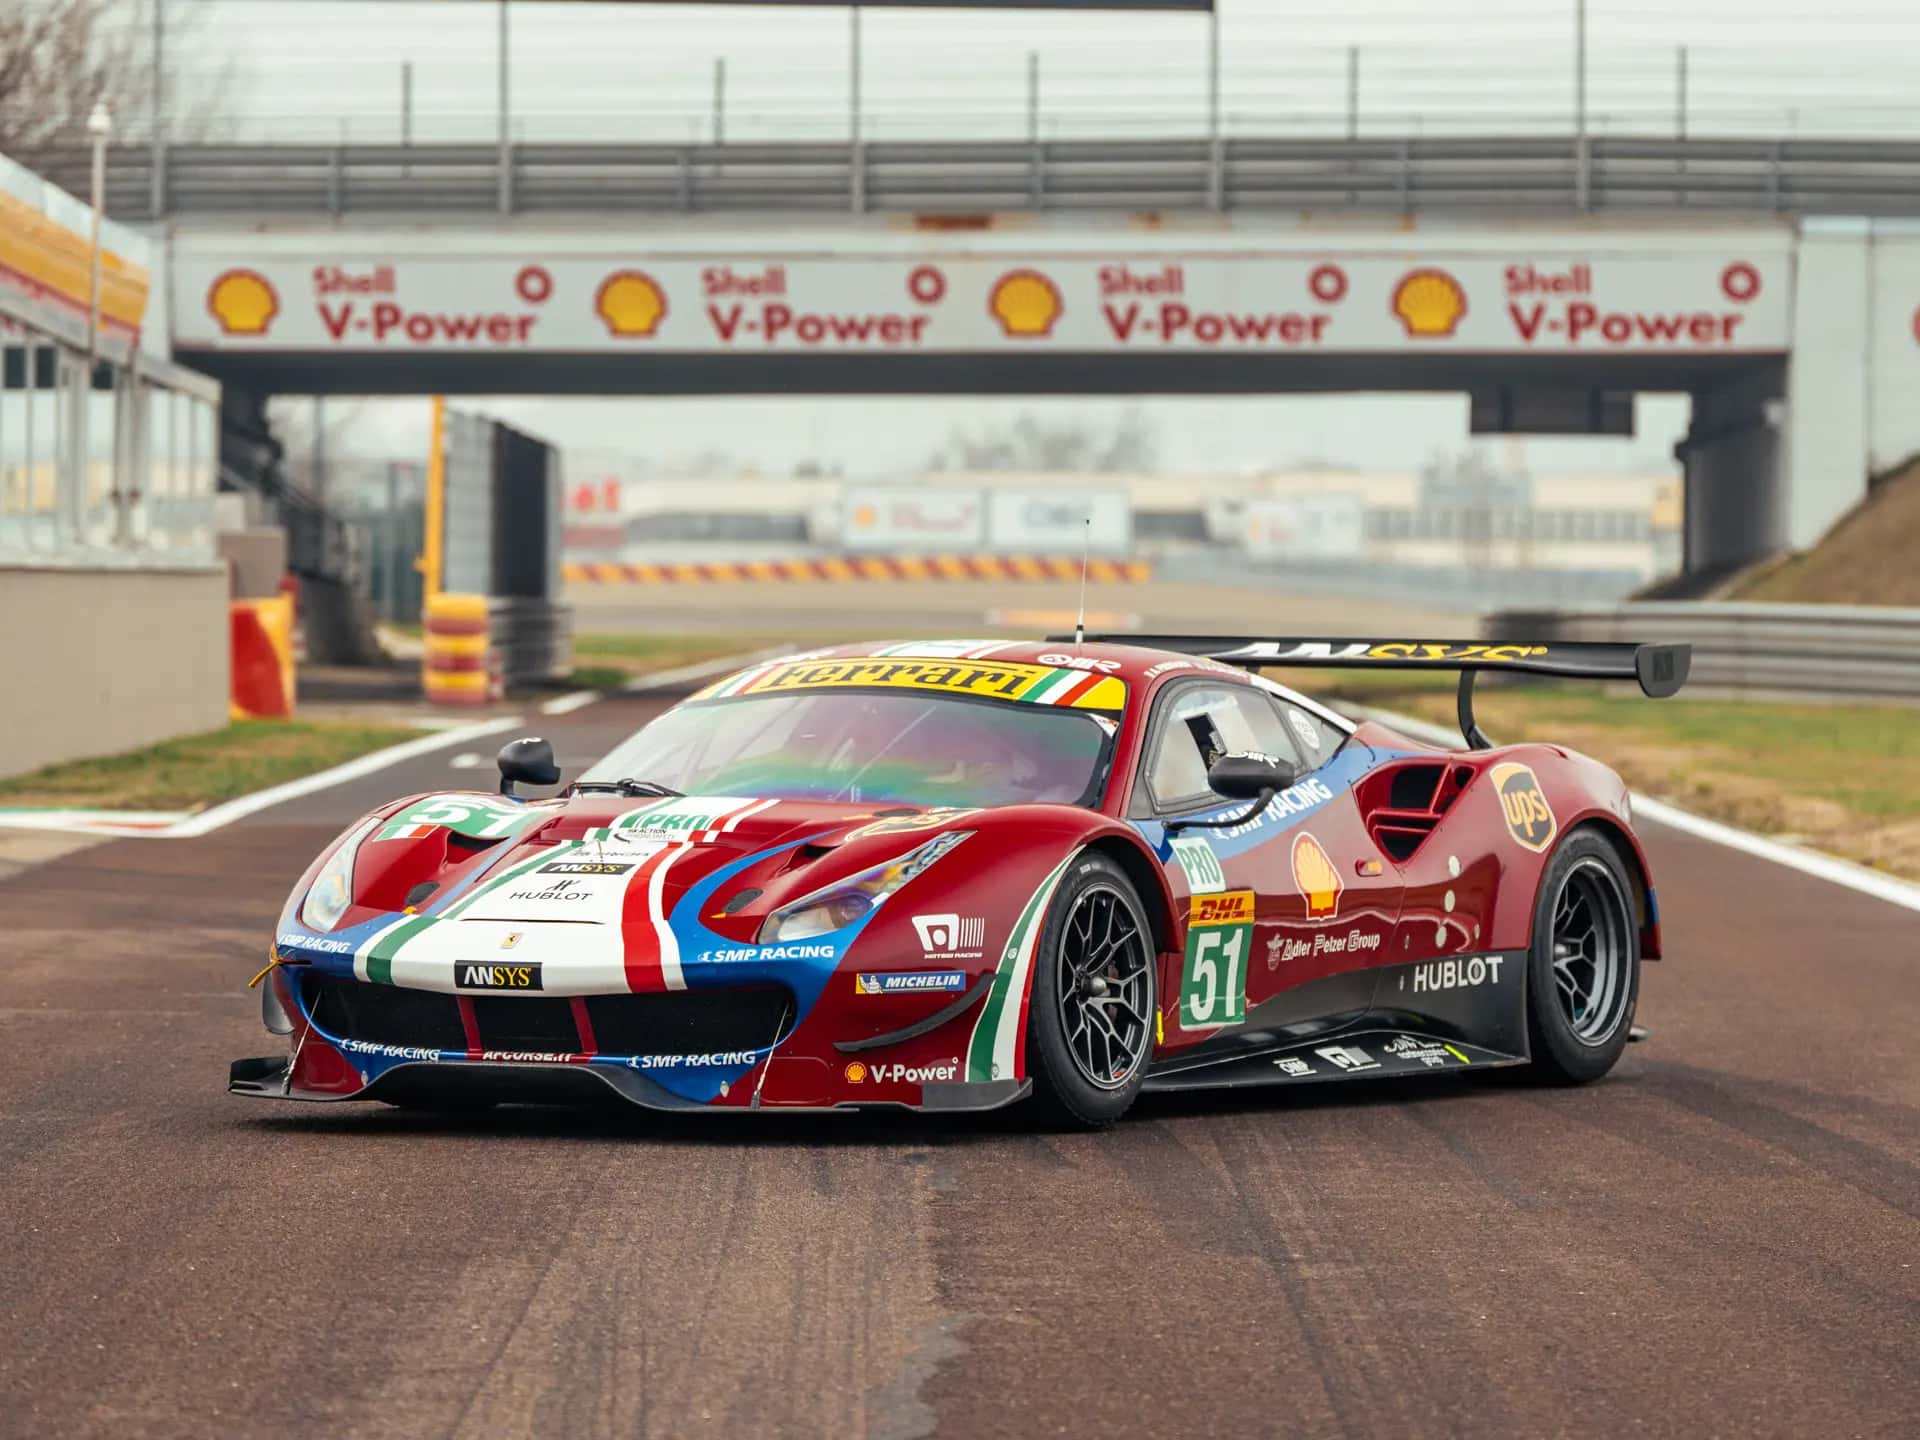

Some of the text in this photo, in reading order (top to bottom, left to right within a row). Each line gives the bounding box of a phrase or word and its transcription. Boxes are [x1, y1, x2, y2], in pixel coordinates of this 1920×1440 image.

[313, 265, 396, 294] Shell
[702, 265, 786, 295] Shell
[1099, 265, 1184, 295] Shell
[1504, 263, 1592, 294] Shell
[317, 303, 537, 343] V-Power
[706, 303, 930, 343] V-Power
[1103, 302, 1330, 343] V-Power
[1508, 301, 1744, 343] V-Power
[760, 660, 1036, 694] Ferrari
[409, 802, 518, 836] 51
[1503, 789, 1549, 838] ups
[549, 863, 625, 873] ANSYS
[1178, 845, 1222, 886] PRO
[508, 892, 594, 901] HUBLOT
[303, 937, 352, 954] RACING
[713, 945, 835, 963] SMP RACING
[1281, 930, 1380, 961] Adler Pelzer Group
[464, 965, 532, 987] ANSYS
[884, 974, 962, 989] MICHELIN
[1190, 928, 1244, 1021] 51
[1413, 956, 1504, 993] HUBLOT
[349, 1040, 442, 1062] SMP RACING
[639, 1051, 757, 1068] SMP RACING
[870, 1064, 957, 1083] V-Power
